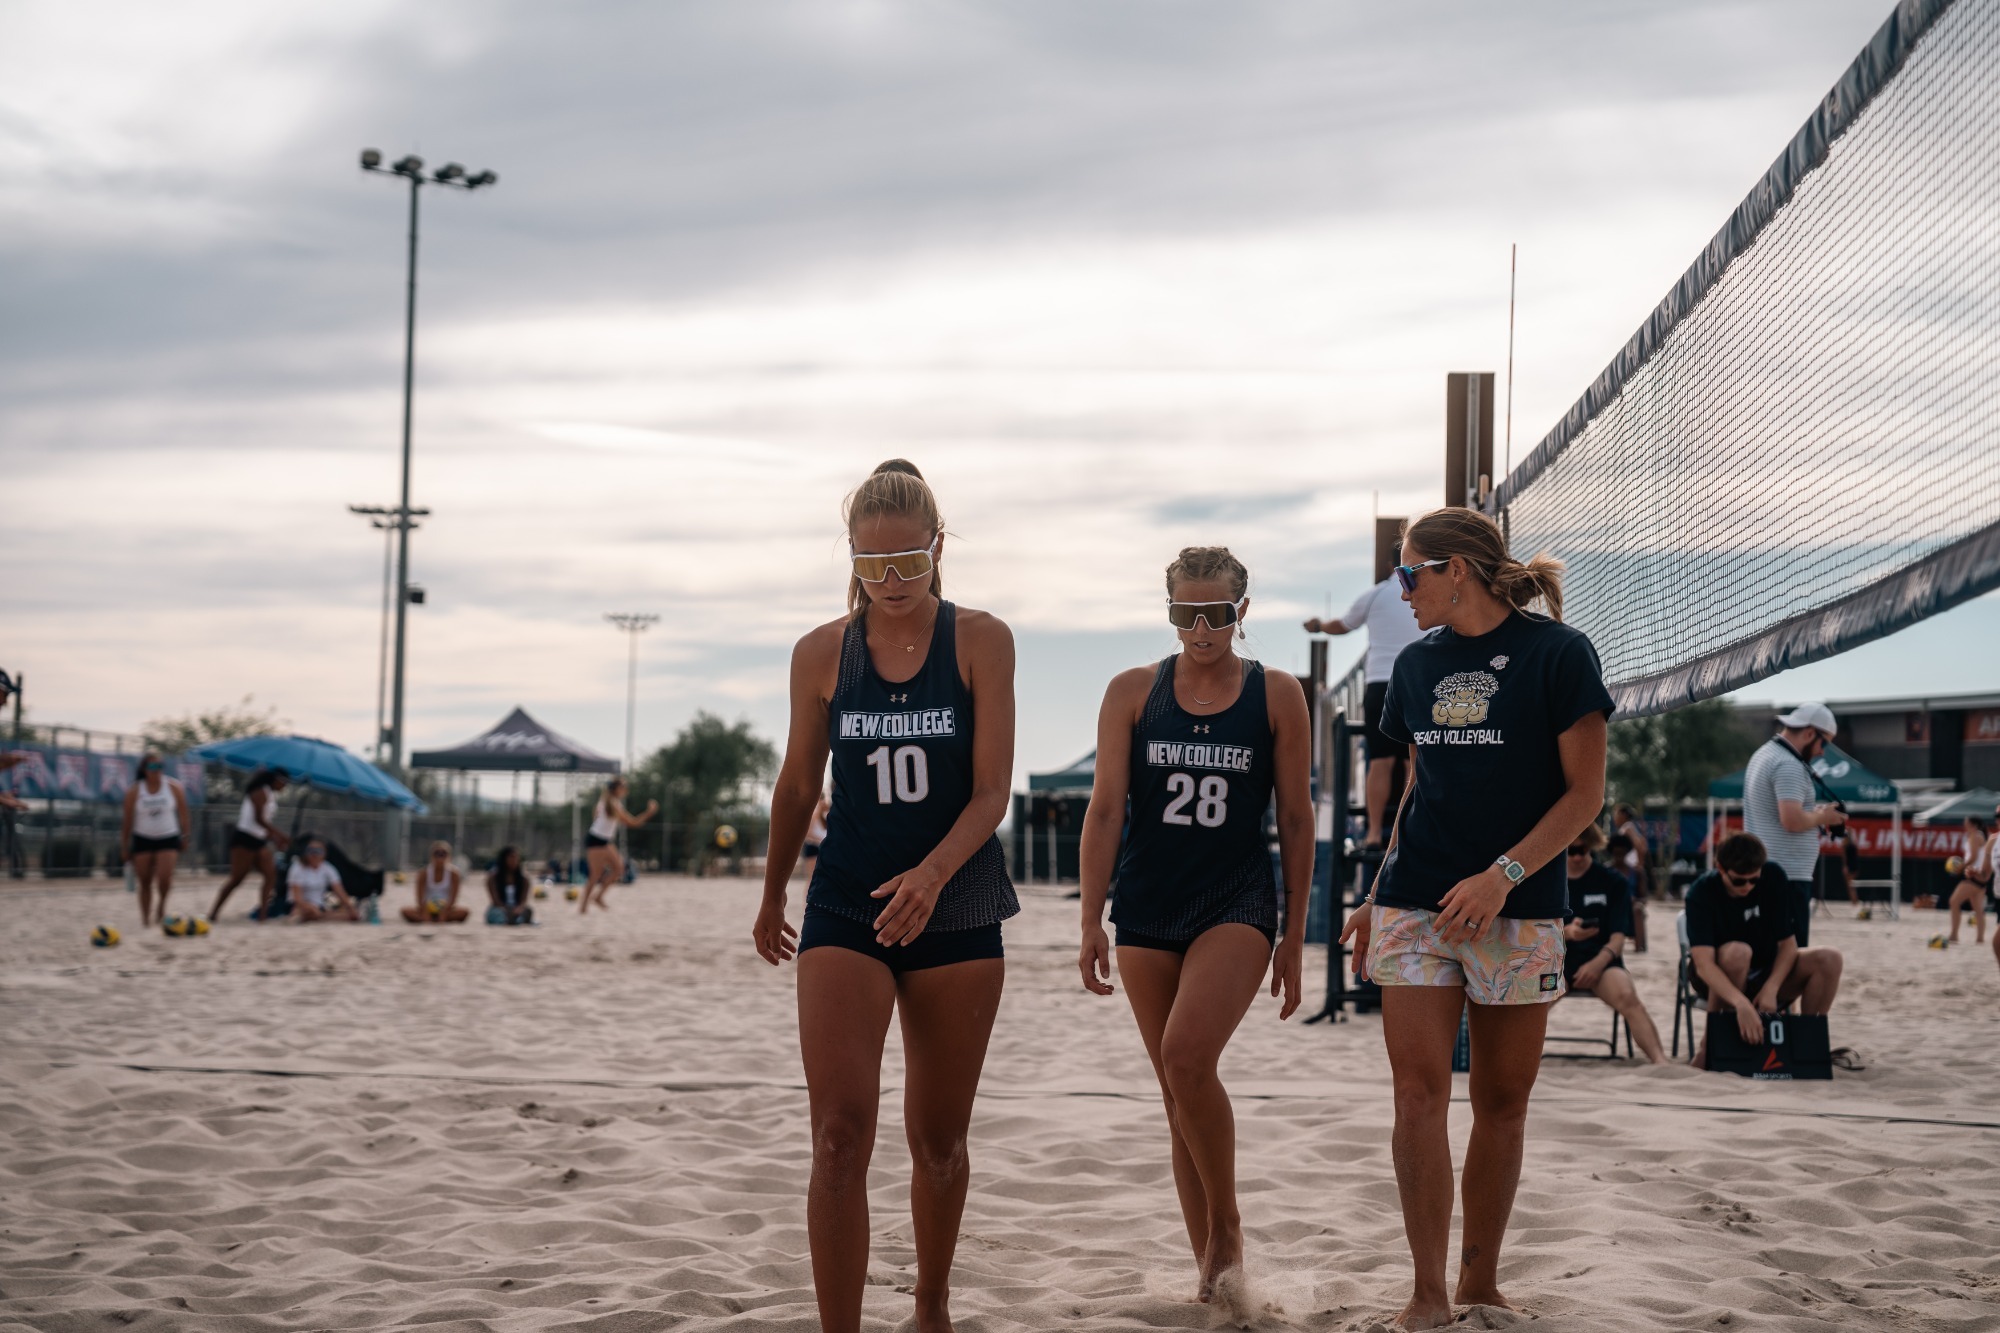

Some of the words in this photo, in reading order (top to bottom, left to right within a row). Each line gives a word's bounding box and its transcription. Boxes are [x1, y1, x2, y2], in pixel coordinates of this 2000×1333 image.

[840, 711, 881, 738] NEW
[881, 708, 954, 738] COLLEGE
[1414, 730, 1441, 745] BEACH
[1443, 729, 1504, 745] VOLLEYBALL
[1148, 741, 1183, 766] NEW
[1183, 744, 1252, 772] COLLEGE
[866, 745, 929, 804] 10
[1162, 772, 1229, 828] 28
[1770, 1020, 1784, 1045] 0
